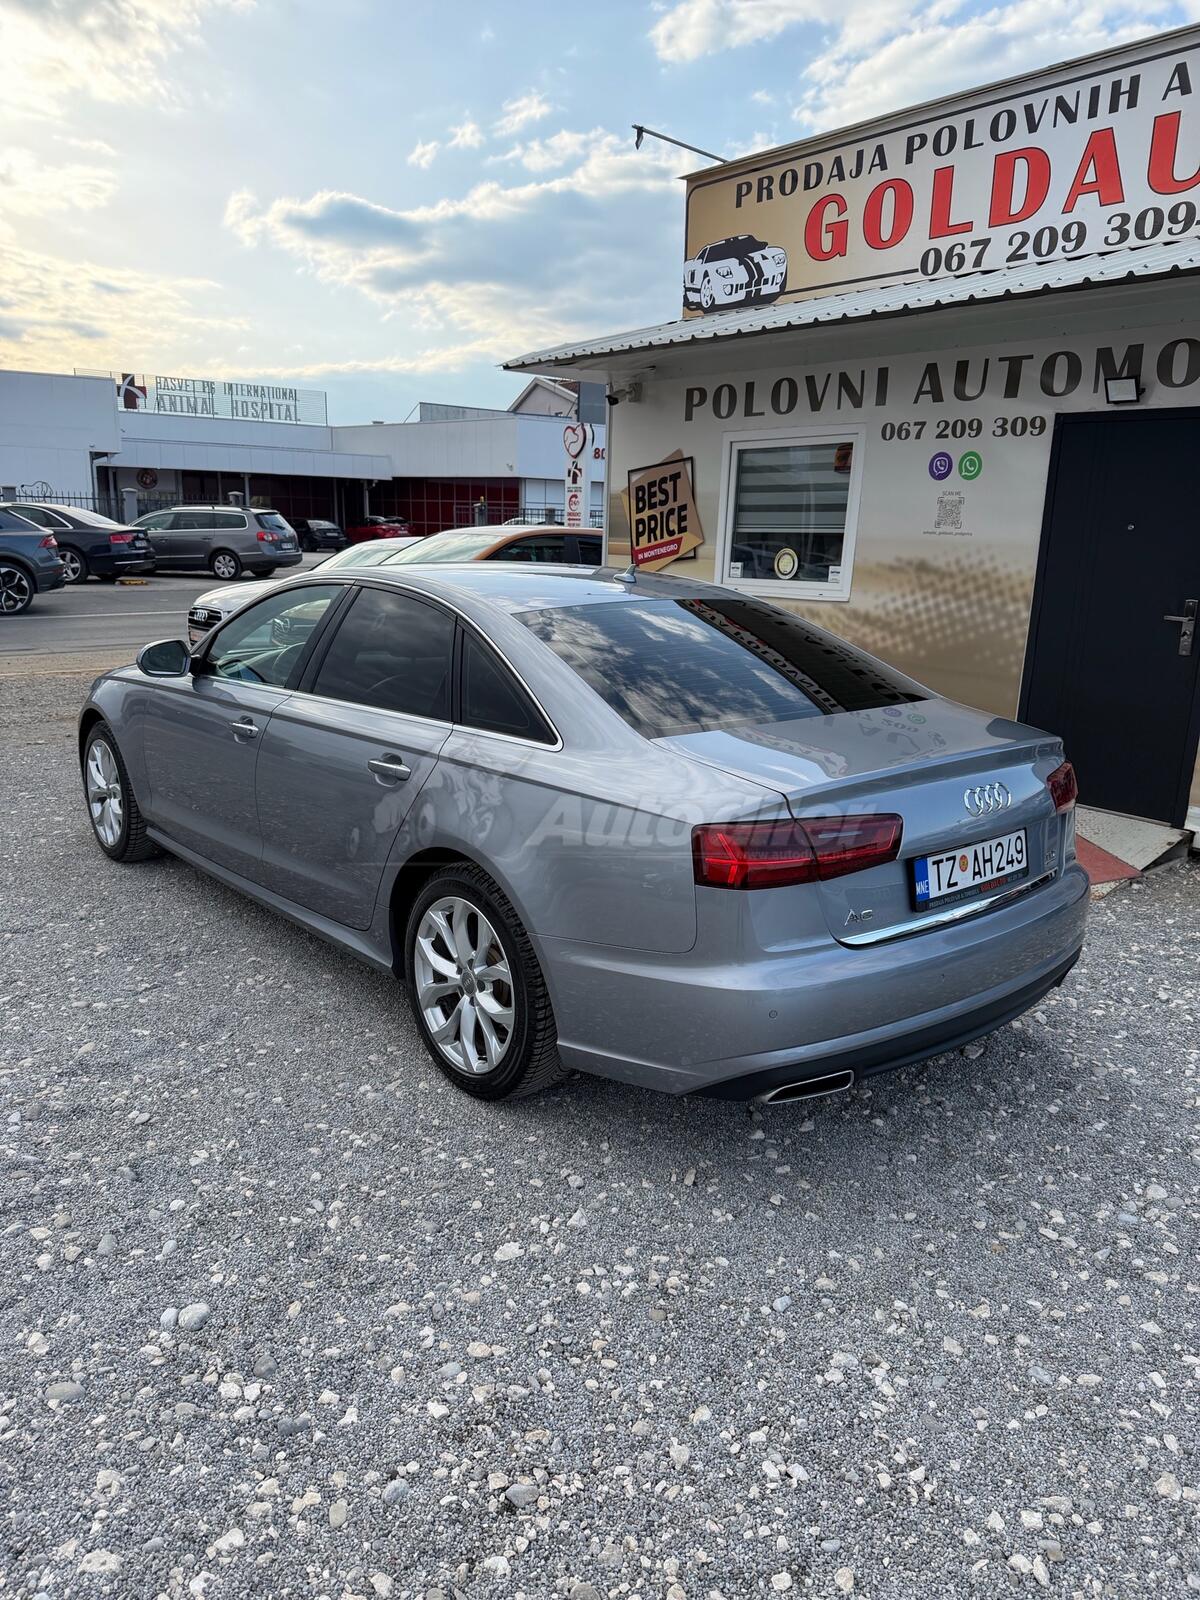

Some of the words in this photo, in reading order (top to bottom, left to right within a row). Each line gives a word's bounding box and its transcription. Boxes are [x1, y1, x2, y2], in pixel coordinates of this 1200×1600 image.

[735, 143, 888, 209] PRODAJA
[904, 73, 1142, 166] POLOVNIH
[1161, 60, 1193, 101] A
[803, 110, 1200, 262] GOLDAU
[919, 237, 992, 277] 067
[1006, 220, 1087, 264] 209
[1103, 200, 1196, 246] 309
[223, 382, 299, 401] INTERNATIONAL
[684, 365, 889, 422] POLOVNI
[913, 337, 1200, 405] AUTOMO
[157, 394, 218, 415] ANIMAL
[231, 399, 301, 422] HOSPITAL
[880, 421, 927, 442] 067
[935, 418, 982, 439] 209
[992, 415, 1047, 437] 309
[635, 471, 681, 515] BEST
[635, 504, 688, 547] PRICE
[644, 543, 678, 558] MONTENEGRO
[931, 855, 960, 893] TZ
[971, 834, 1025, 882] AH249
[915, 879, 930, 896] MNE
